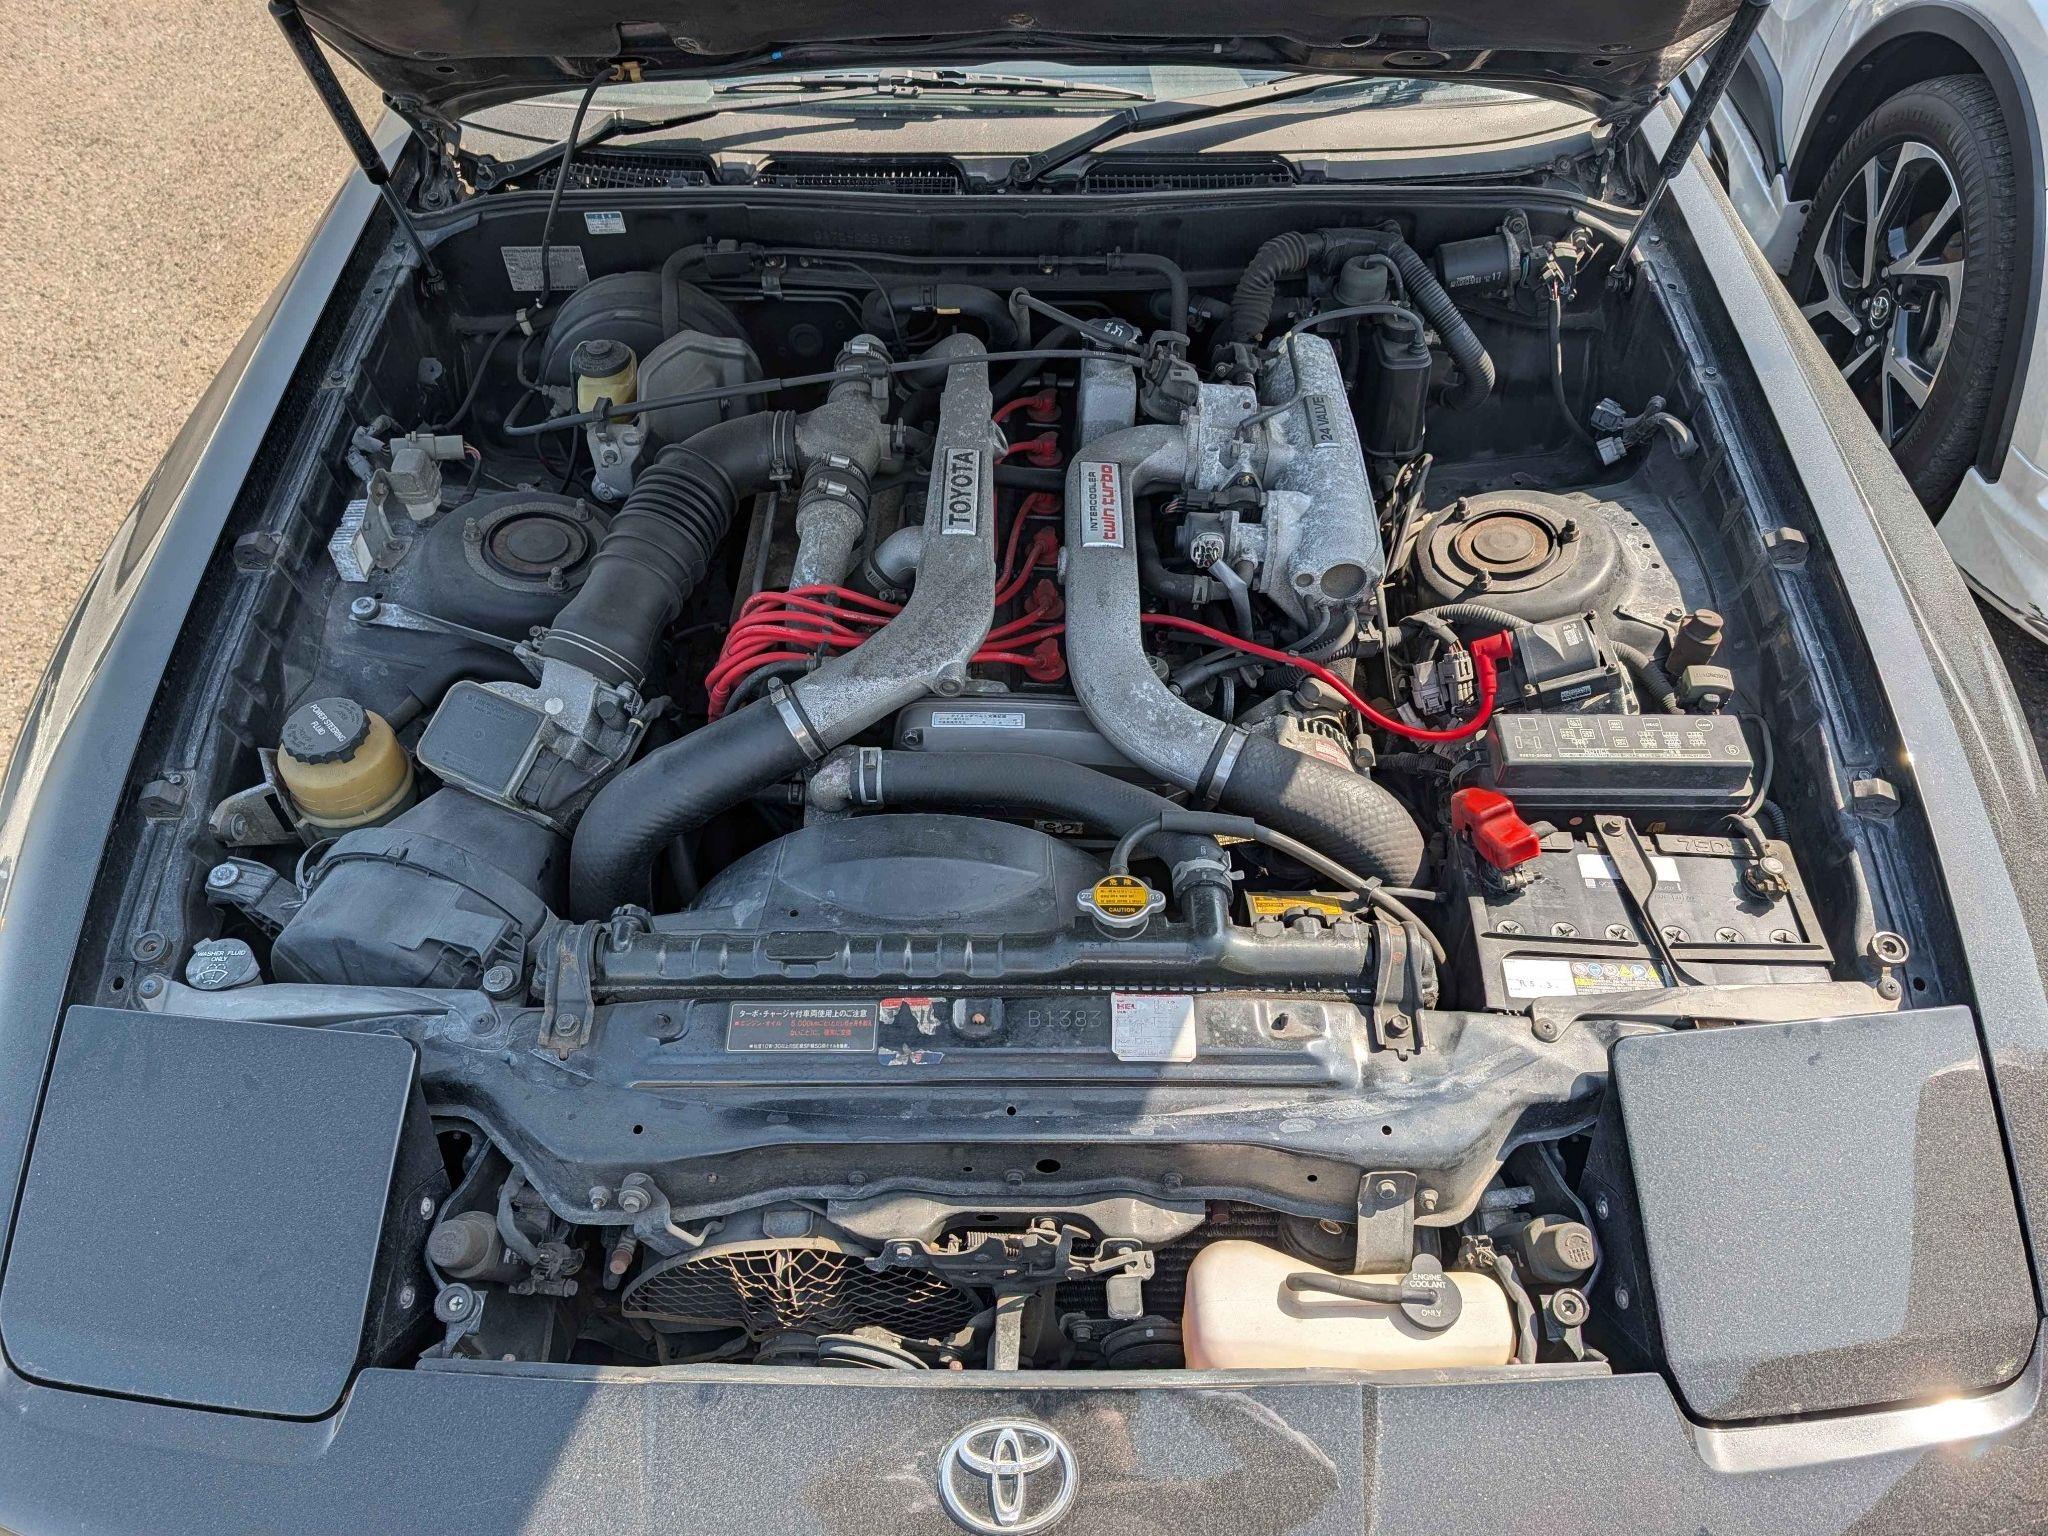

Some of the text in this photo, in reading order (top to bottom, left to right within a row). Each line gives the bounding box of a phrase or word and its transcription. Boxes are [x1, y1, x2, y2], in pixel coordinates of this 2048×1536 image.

[1313, 397, 1333, 441] 24 VALVE
[948, 451, 974, 526] TOYOTA
[1088, 471, 1098, 532] INTERCOOLER
[1101, 464, 1116, 539] twin turbo
[310, 704, 327, 721] POWER
[324, 719, 347, 742] STEERING
[310, 721, 326, 735] FLUID
[1409, 1280, 1447, 1289] COOLANT
[1412, 1273, 1443, 1281] ENGINE
[1421, 1309, 1442, 1318] ONLY
